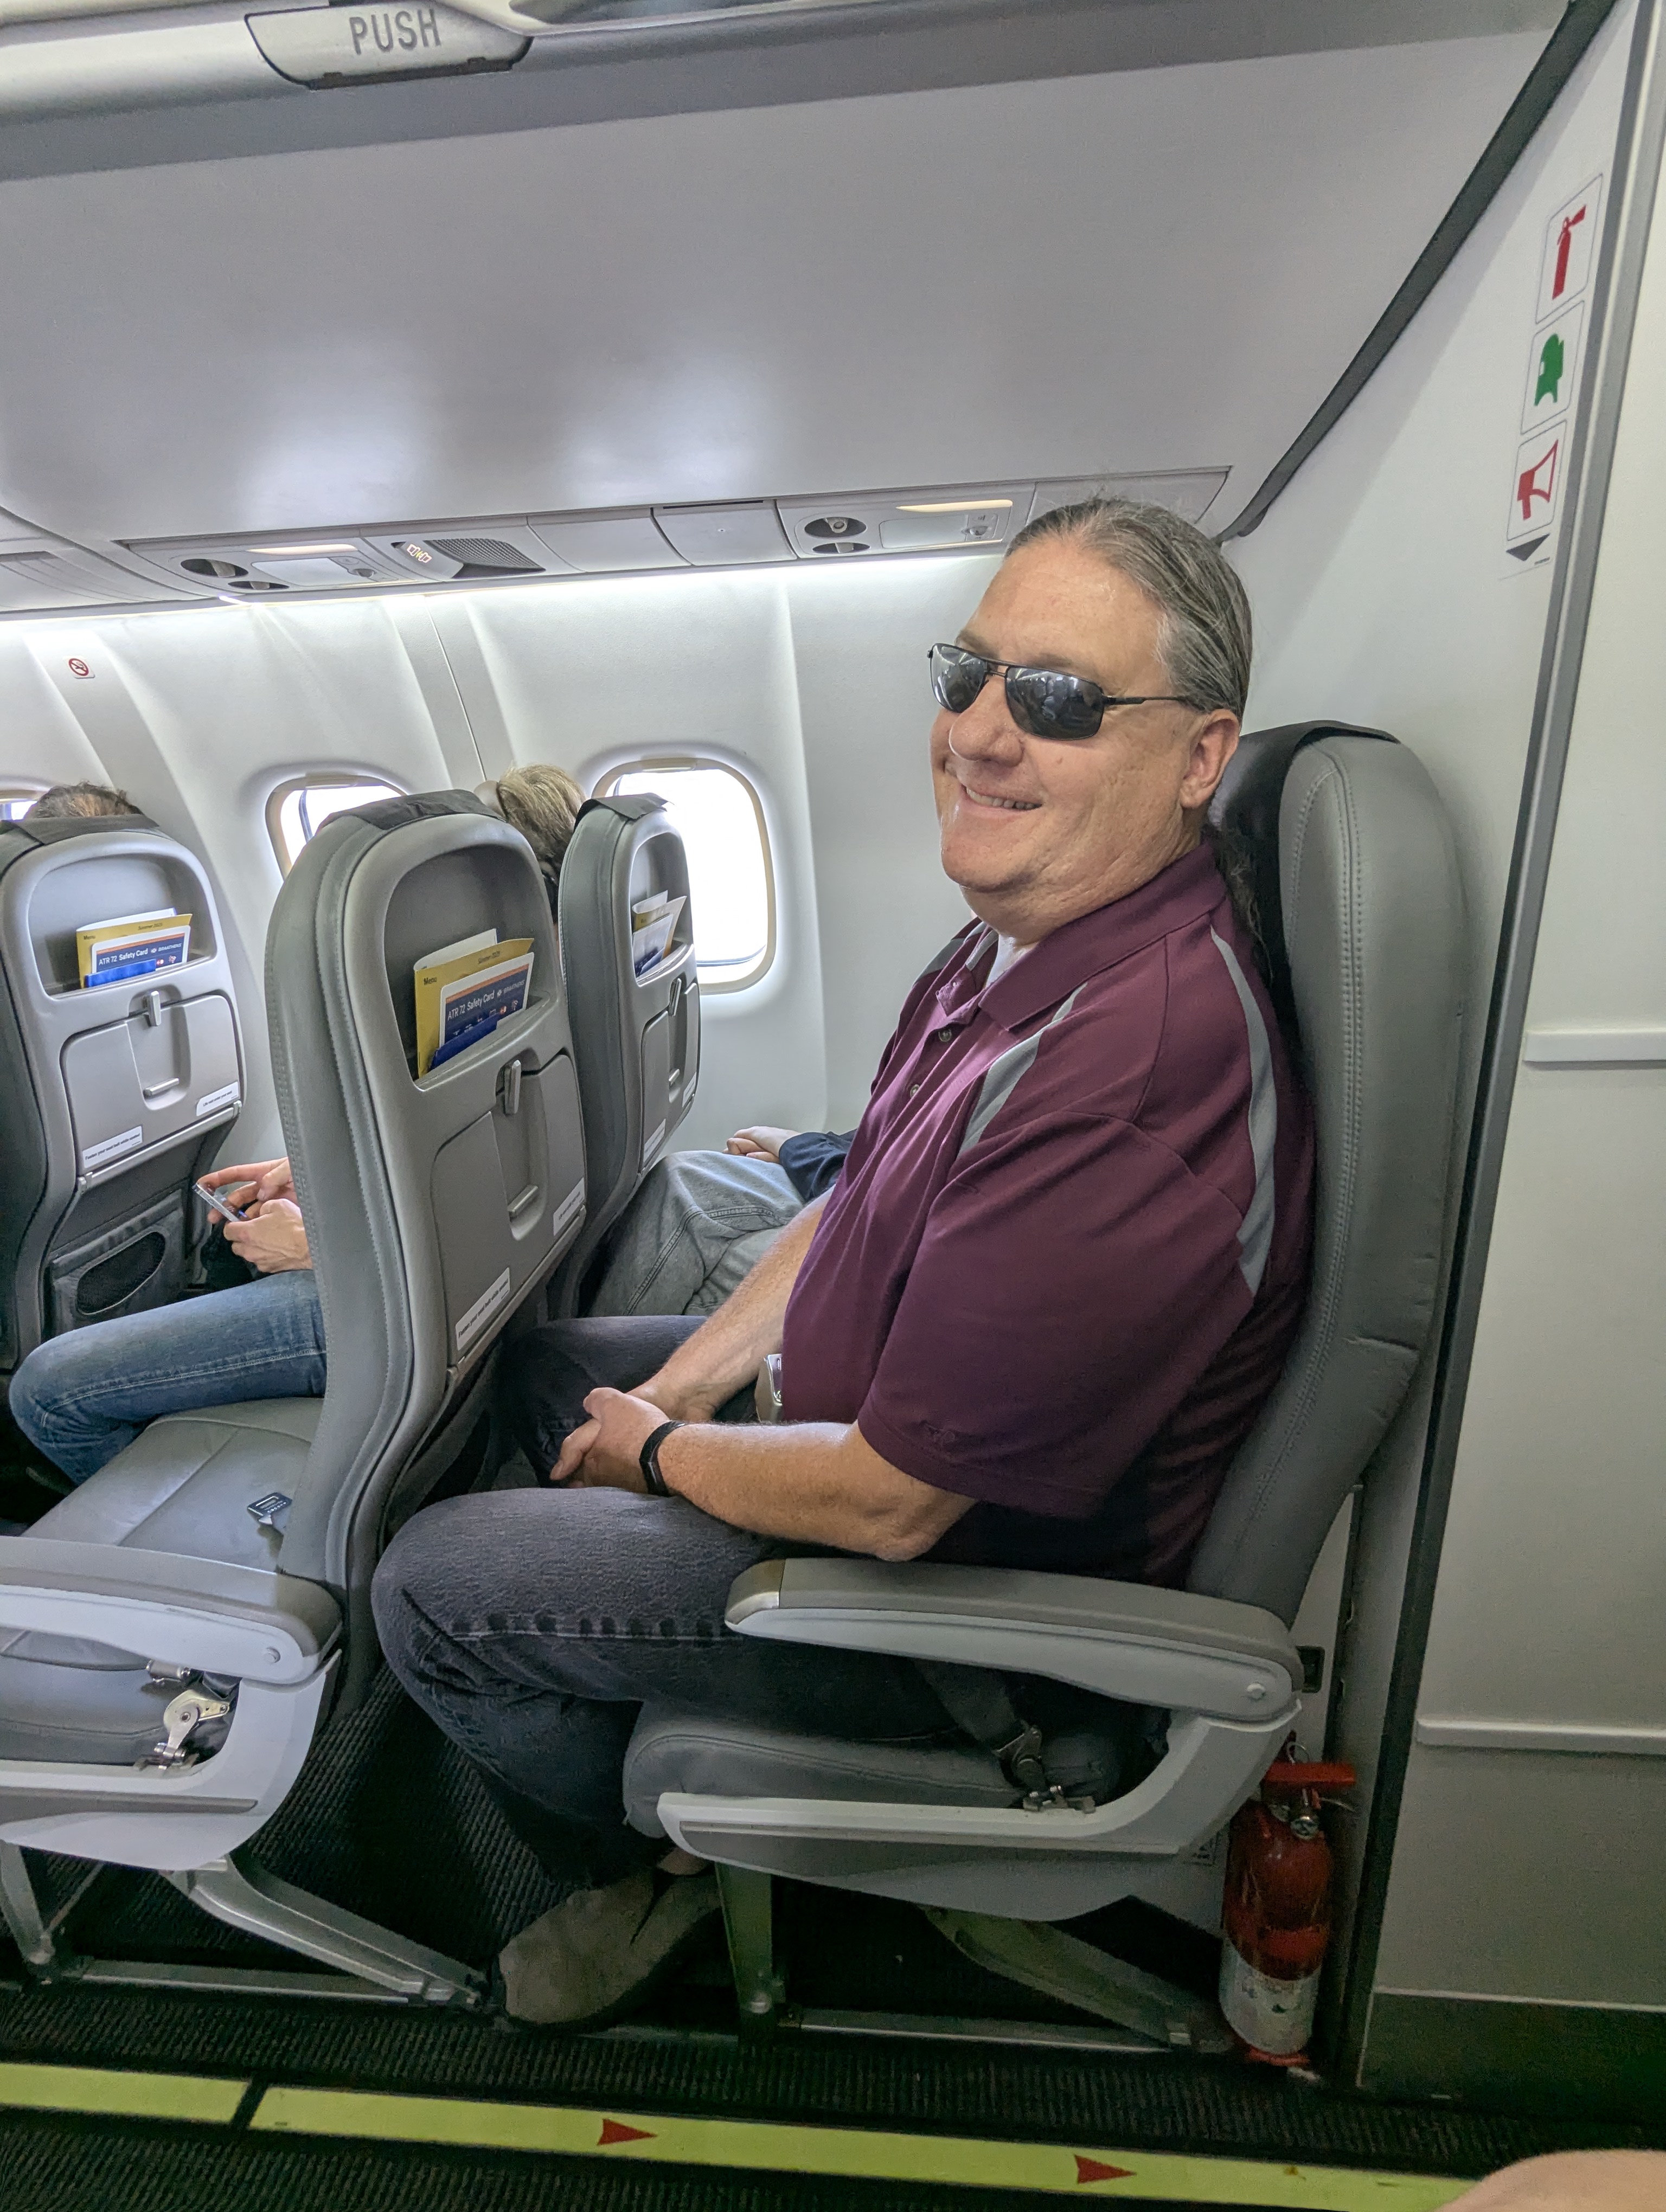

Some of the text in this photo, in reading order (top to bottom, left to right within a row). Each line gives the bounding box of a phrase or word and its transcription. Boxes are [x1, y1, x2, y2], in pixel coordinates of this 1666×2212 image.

[349, 8, 441, 55] PUSH
[99, 957, 110, 966] ATR
[119, 952, 135, 961] Safety
[136, 948, 148, 956] Card
[424, 977, 437, 986] Menu
[447, 1008, 459, 1021] ATR
[459, 1004, 466, 1014] 72
[467, 998, 482, 1011] Safety
[483, 989, 495, 1003] Card
